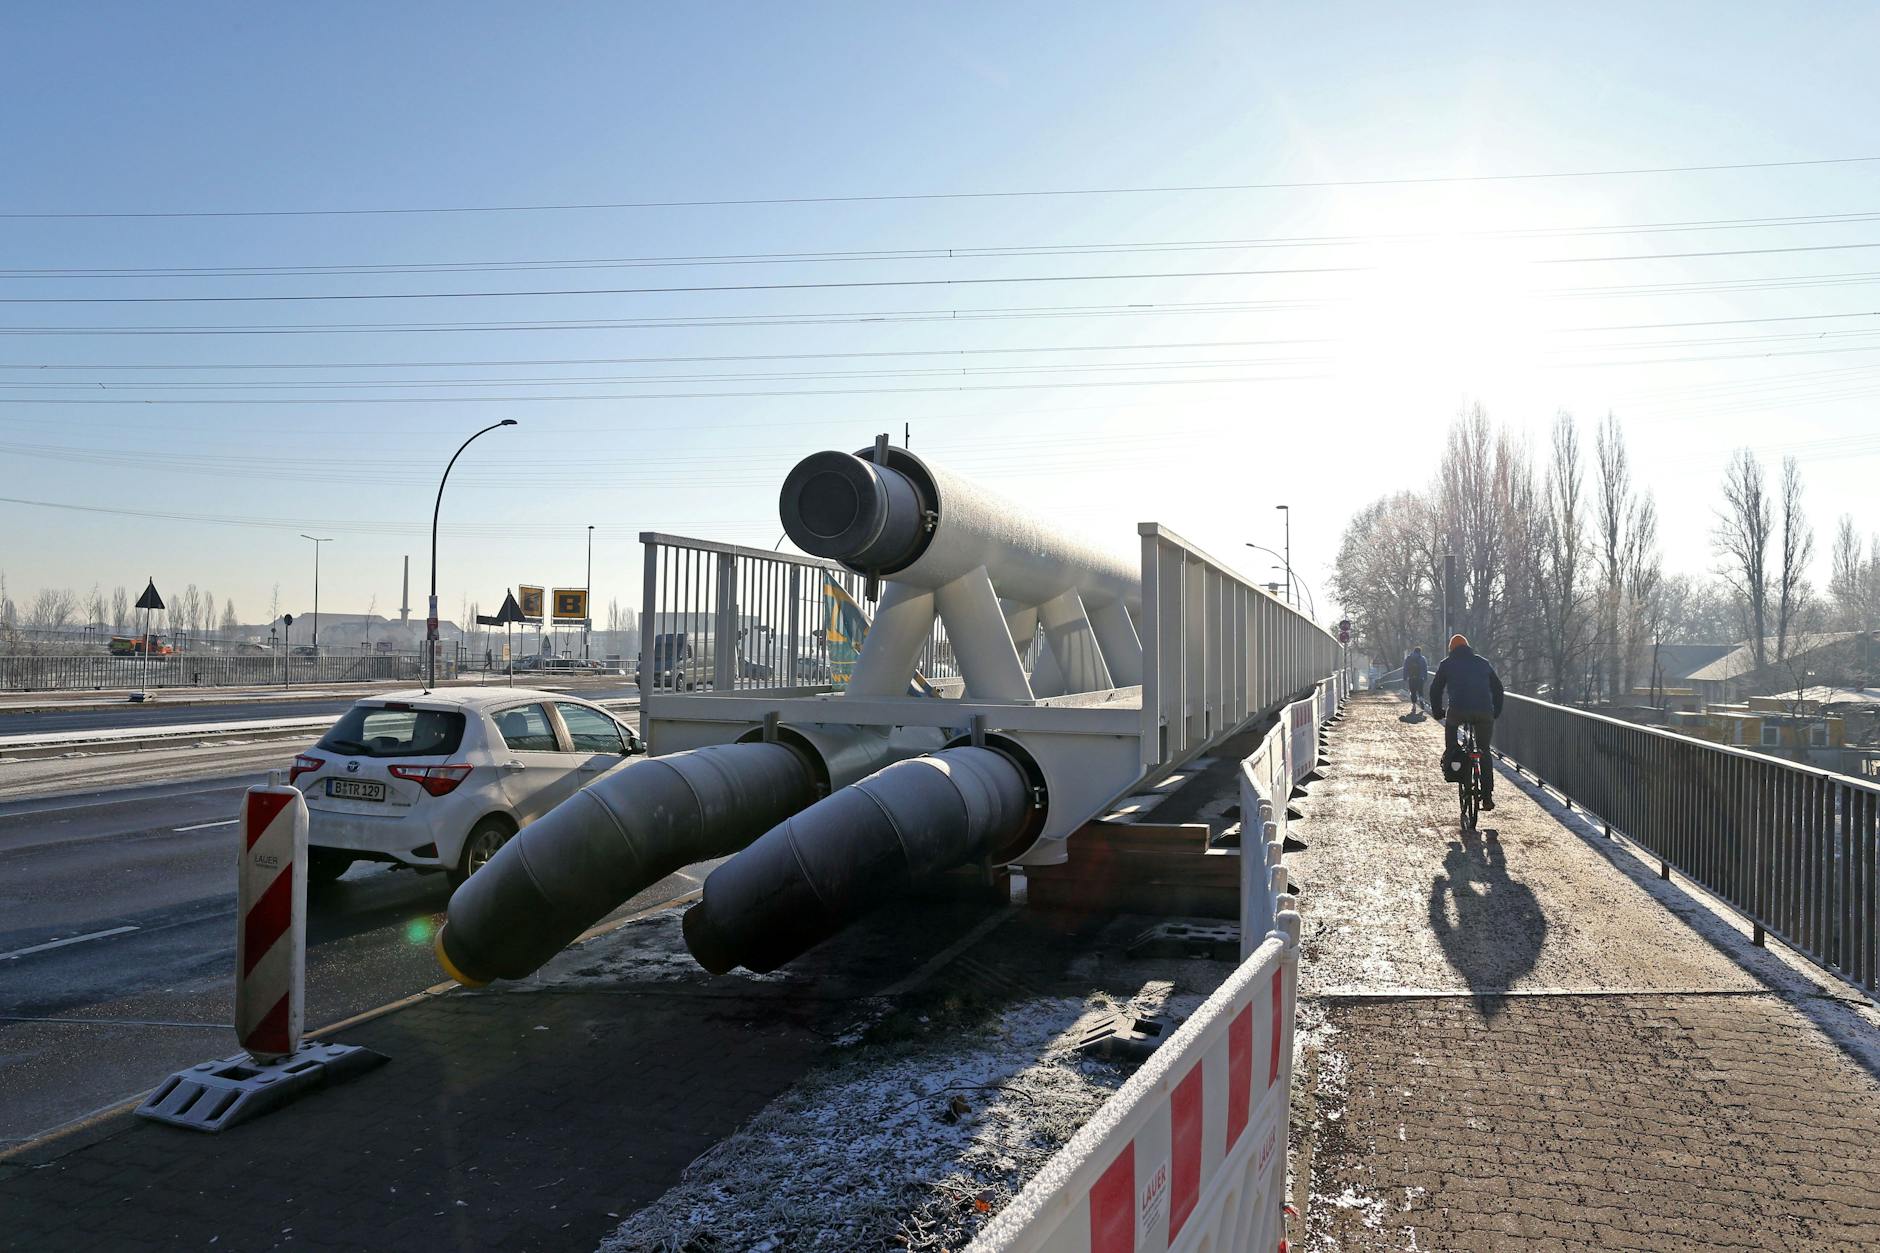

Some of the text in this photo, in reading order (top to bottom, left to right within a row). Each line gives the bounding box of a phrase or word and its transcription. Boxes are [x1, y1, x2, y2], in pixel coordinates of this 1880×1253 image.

[335, 782, 380, 797] B TR 129
[1258, 1126, 1276, 1171] LAUER
[1142, 1164, 1167, 1211] LAUER
